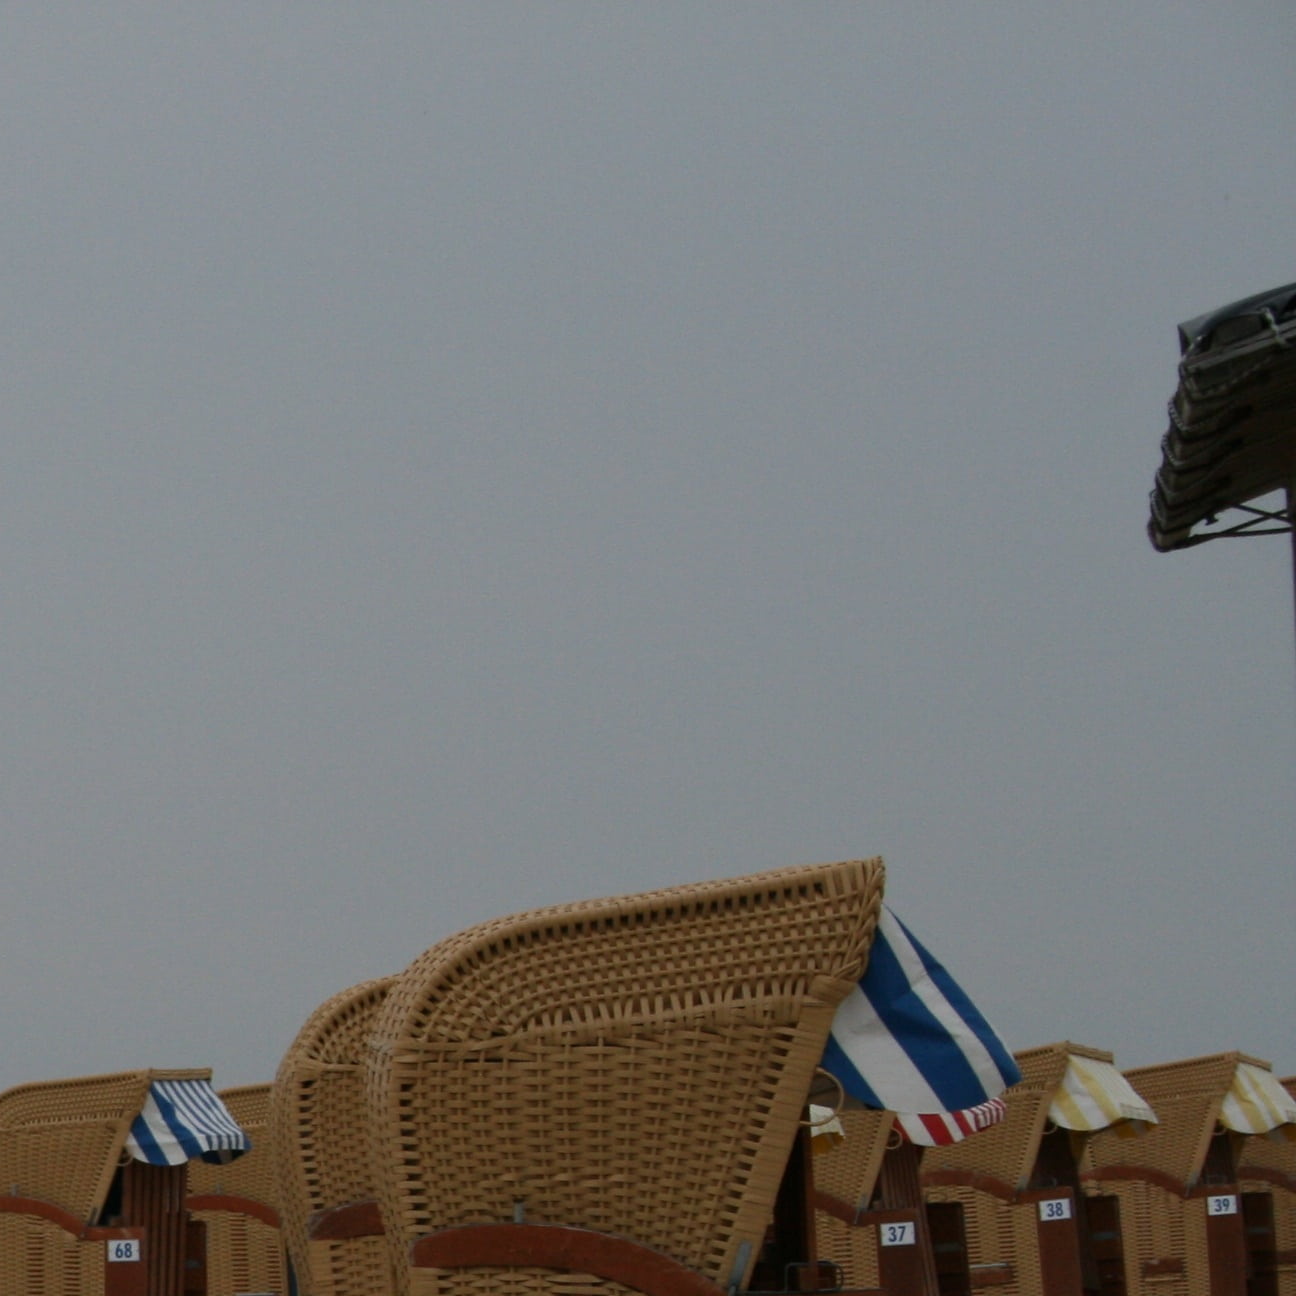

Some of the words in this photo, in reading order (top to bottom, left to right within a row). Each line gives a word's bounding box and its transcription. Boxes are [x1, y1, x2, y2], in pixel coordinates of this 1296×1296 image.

[1047, 1202, 1064, 1218] 38
[1214, 1197, 1230, 1213] 39
[888, 1225, 906, 1243] 37
[114, 1242, 133, 1259] 68
